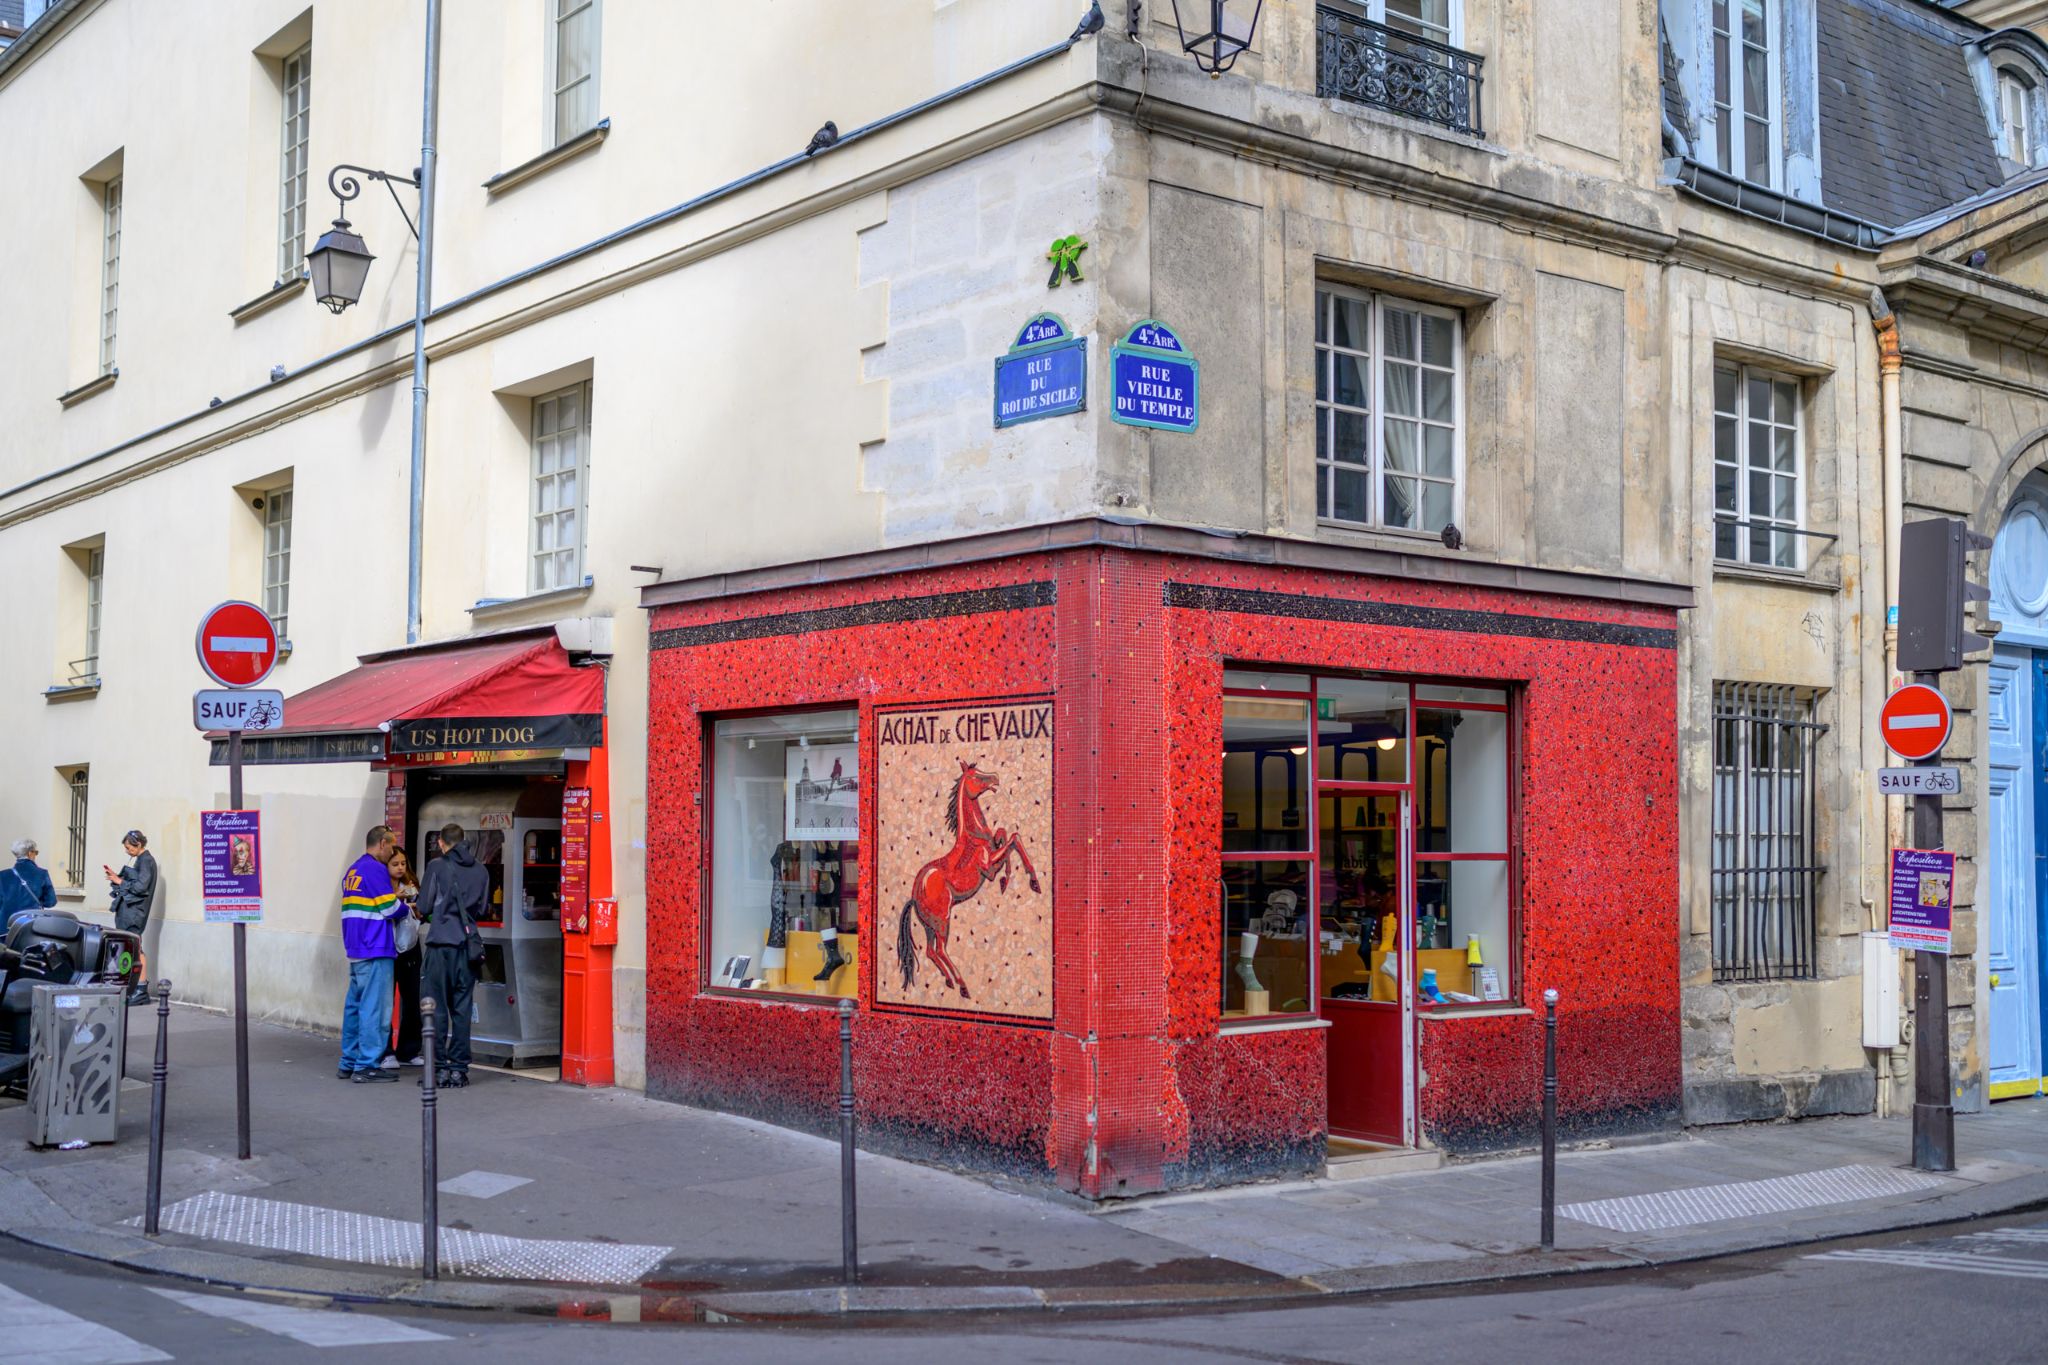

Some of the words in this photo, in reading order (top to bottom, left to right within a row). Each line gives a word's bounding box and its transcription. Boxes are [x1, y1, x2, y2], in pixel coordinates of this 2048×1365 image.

[1027, 358, 1052, 375] RUE
[1141, 365, 1170, 383] RUE
[1031, 376, 1048, 392] DU
[1127, 380, 1183, 402] VIEILLE
[1002, 400, 1021, 415] ROI
[1022, 397, 1038, 411] DE
[1039, 386, 1077, 408] SICILE
[1117, 397, 1136, 411] DU
[1140, 400, 1194, 420] TEMPLE
[201, 702, 247, 718] SAUF
[881, 716, 939, 745] ACHAT
[939, 729, 951, 744] DE
[956, 708, 1050, 742] CHEVAUX
[410, 730, 437, 747] US
[443, 728, 485, 745] HOT
[490, 727, 536, 744] DOG
[1881, 775, 1921, 787] SAUF
[206, 814, 248, 829] Exposition
[795, 817, 859, 828] PARIS
[1898, 851, 1943, 866] Exposition
